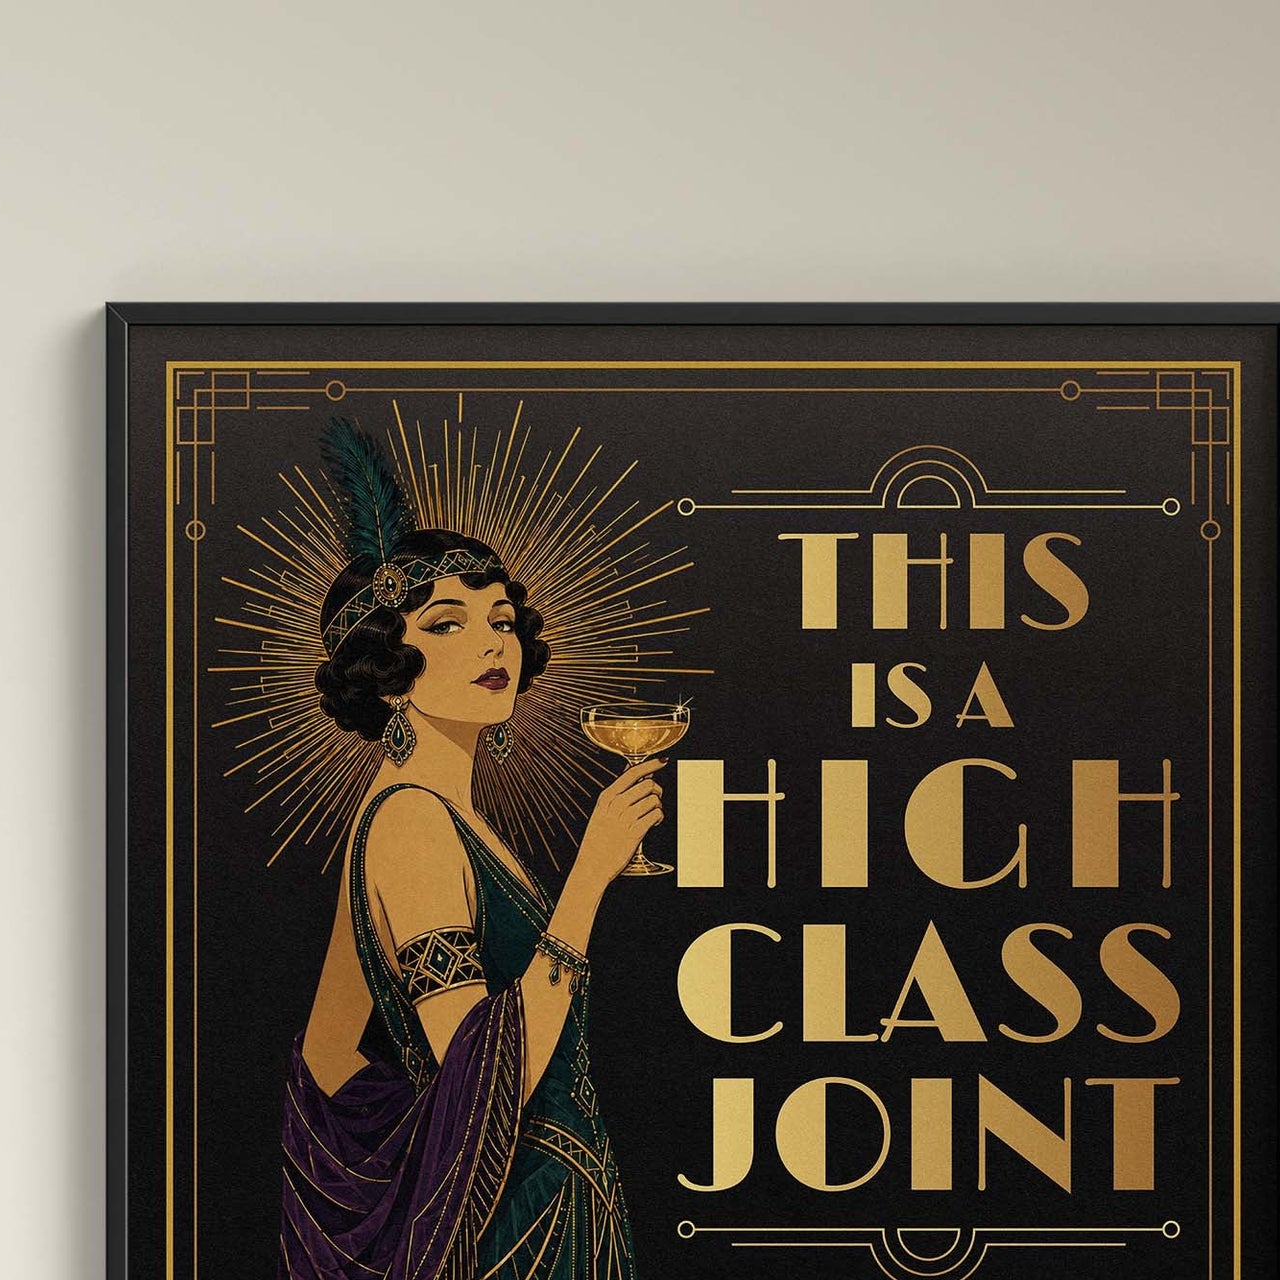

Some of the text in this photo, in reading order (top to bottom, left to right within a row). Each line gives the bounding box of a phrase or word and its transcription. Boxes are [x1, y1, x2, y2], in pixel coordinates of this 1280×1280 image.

[777, 532, 1090, 631] THIS
[851, 661, 1015, 729] IS A
[676, 757, 1181, 890] HIGH
[676, 921, 1181, 1044] CLASS
[676, 1075, 1181, 1194] JOINT
